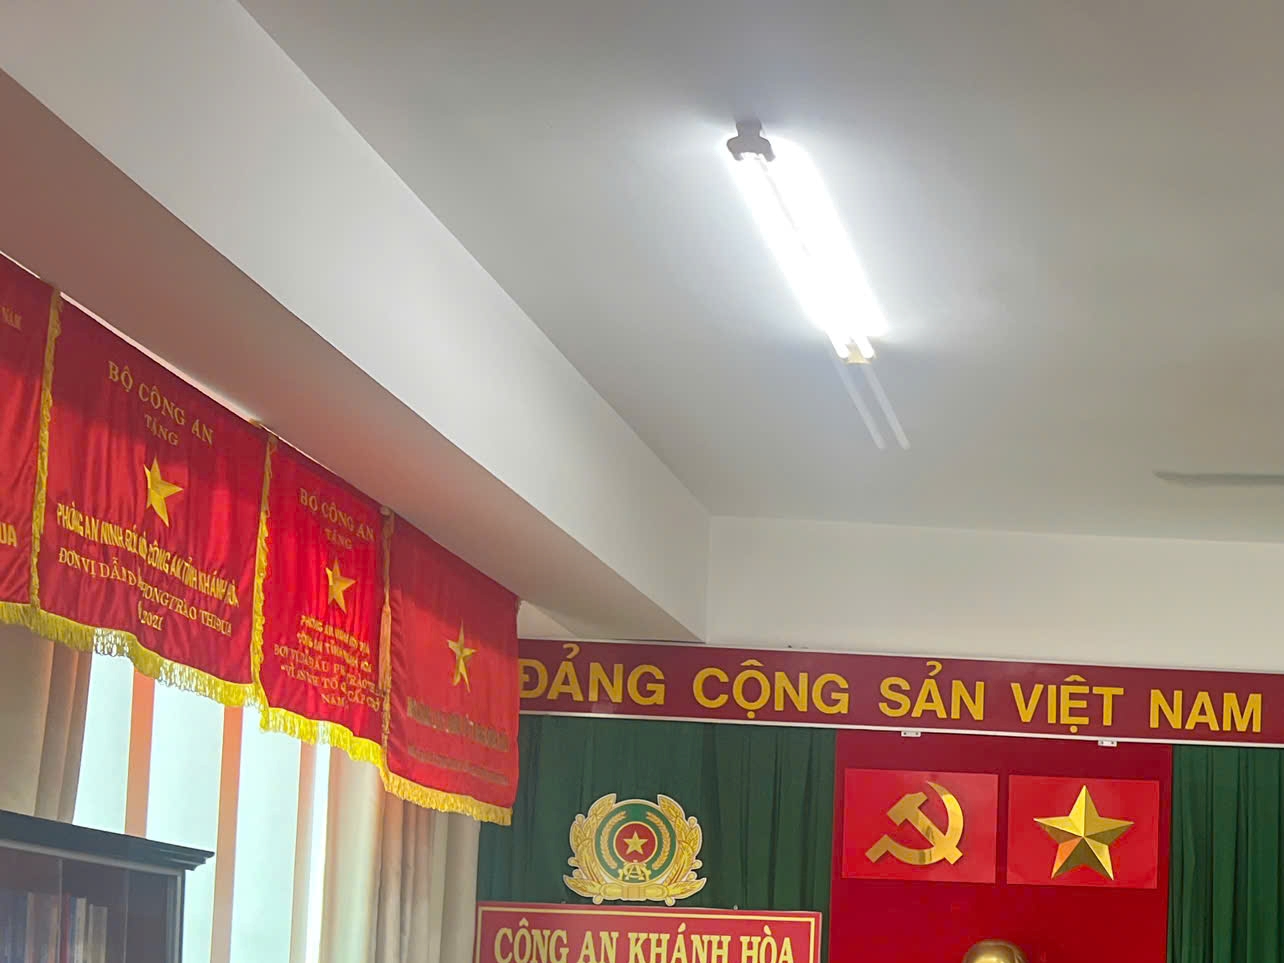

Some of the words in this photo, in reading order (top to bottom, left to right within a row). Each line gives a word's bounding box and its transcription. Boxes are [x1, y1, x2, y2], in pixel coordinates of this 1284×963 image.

[108, 361, 134, 392] BỘ
[138, 383, 187, 426] CÔNG
[191, 418, 214, 445] AN
[321, 502, 354, 532] CÔNG
[356, 523, 376, 541] AN
[81, 557, 96, 578] VỊ
[520, 643, 666, 706] ĐẢNG
[692, 659, 850, 720] CỘNG
[878, 660, 985, 721] SẢN
[1011, 674, 1124, 734] VIỆT
[1150, 689, 1263, 733] NAM
